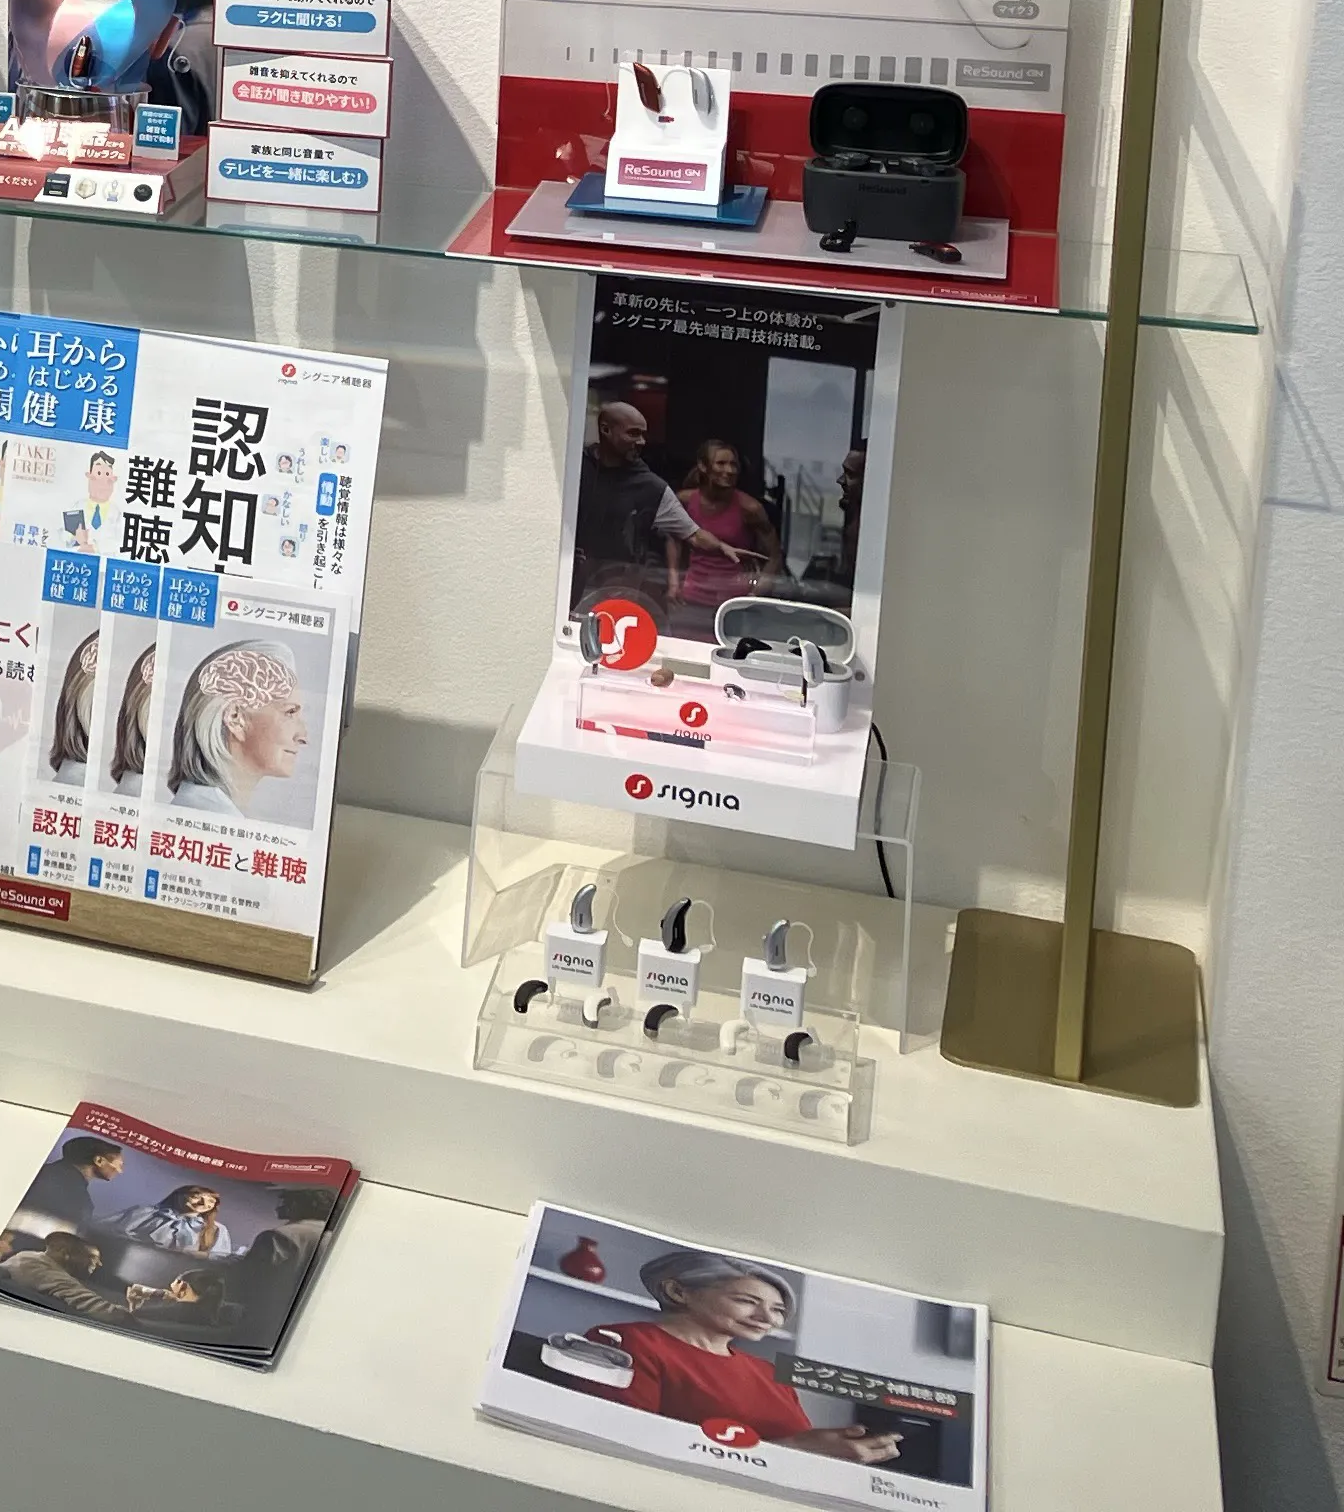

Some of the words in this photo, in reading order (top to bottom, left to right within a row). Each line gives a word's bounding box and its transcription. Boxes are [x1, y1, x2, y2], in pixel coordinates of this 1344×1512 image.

[256, 9, 343, 28] ラクに聞ける！
[248, 65, 358, 86] 雑音を抑えてくれるので
[962, 65, 1024, 81] ReSound
[237, 84, 372, 111] 会話が聞き取りやすい！
[250, 144, 335, 161] 家族と同じ音量で
[223, 163, 363, 185] テレビを一緒に楽しむ！
[623, 162, 683, 179] ReSound
[683, 167, 702, 179] GN
[613, 290, 825, 332] 革新の先に、一つ上の体験が。
[612, 310, 824, 352] シグニア最先端音声技術搭載。
[26, 329, 127, 371] 耳から
[27, 364, 120, 397] はじめる
[302, 370, 373, 389] シグニア補聴器
[22, 388, 117, 436] 健康
[14, 441, 57, 463] TAKE
[318, 437, 330, 465] 楽しい
[12, 459, 56, 478] FREE
[295, 447, 307, 485] うれしい
[120, 454, 178, 565] 難聴
[280, 490, 293, 527] かなしい
[330, 475, 353, 576] 聴覚情報は様々な
[50, 573, 91, 592] はじめる
[110, 568, 154, 588] 耳から
[242, 604, 326, 629] シグニア補聴器
[656, 781, 741, 813] signia
[149, 830, 308, 885] 認知症と難聴
[162, 871, 178, 883] 小川
[160, 880, 229, 904] 慶應義塾大学医学部
[230, 894, 261, 910] 名誉教授
[750, 990, 795, 1008] signia
[793, 1360, 959, 1407] シグニア補聴器
[687, 1439, 768, 1469] signia
